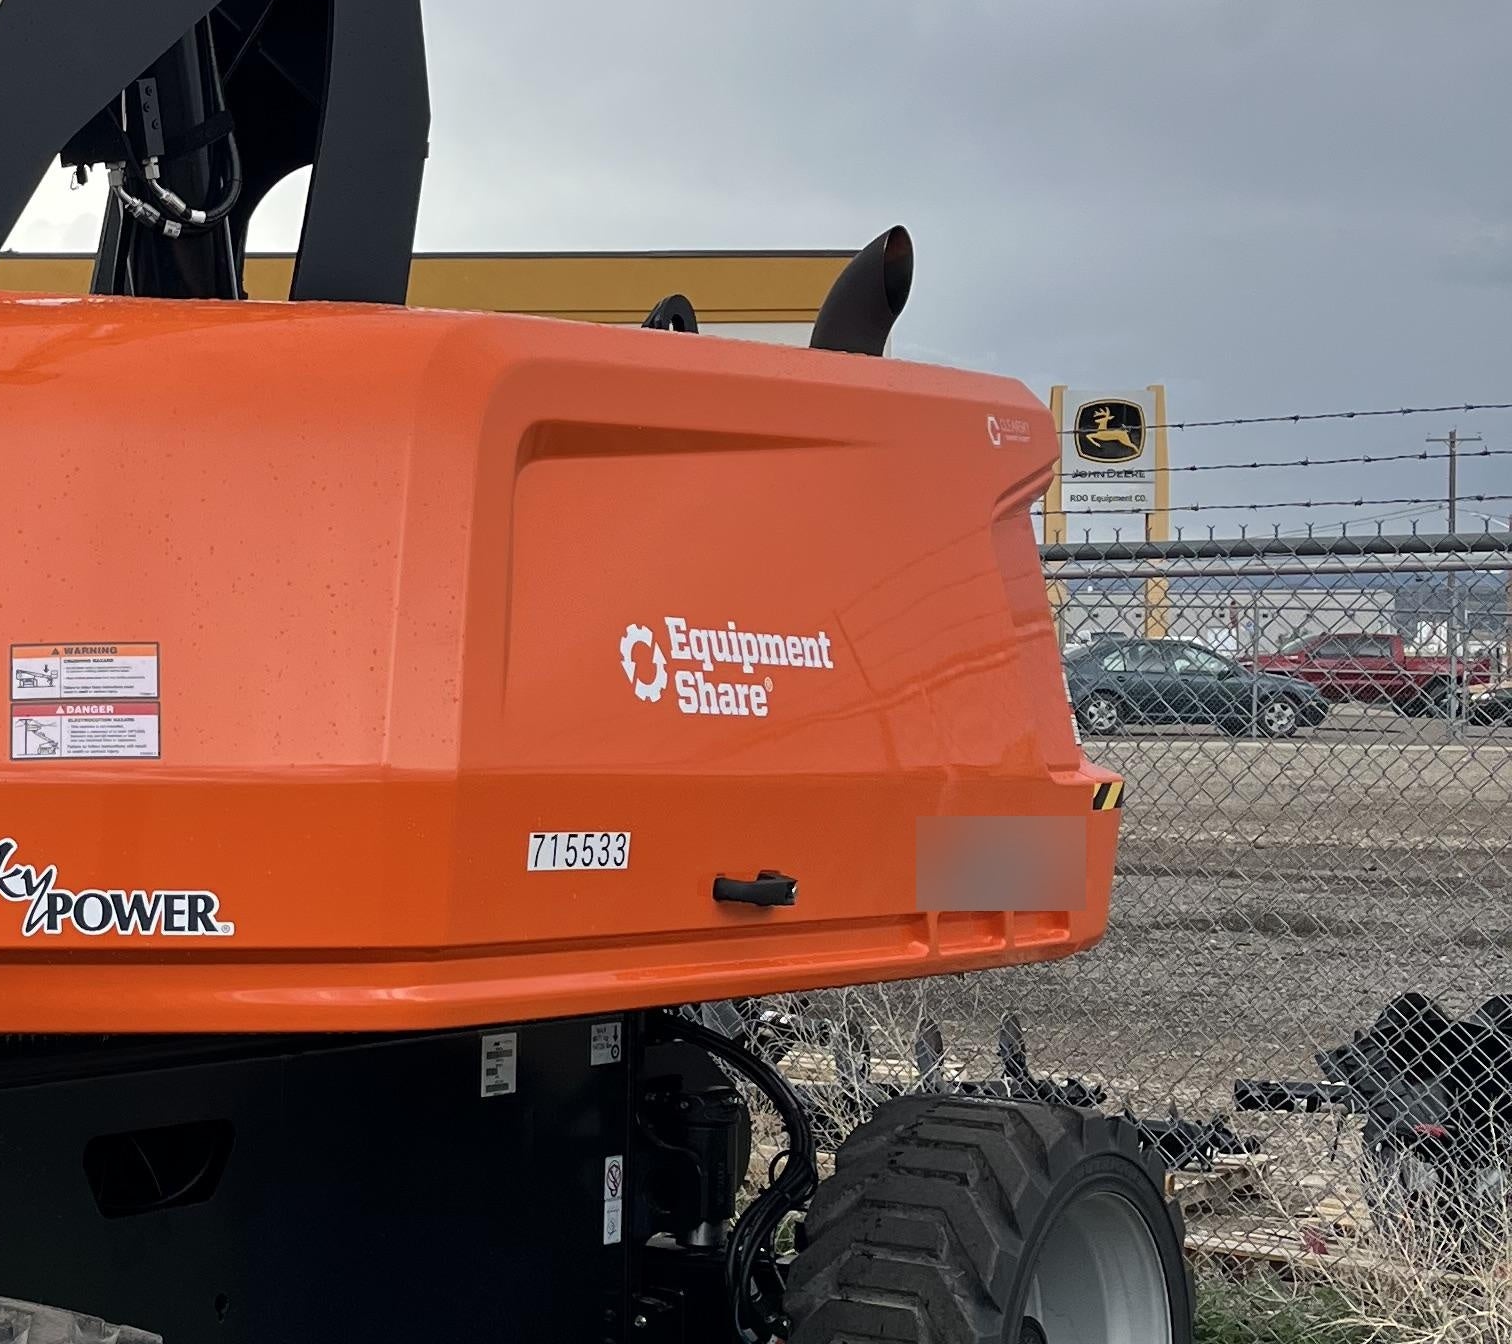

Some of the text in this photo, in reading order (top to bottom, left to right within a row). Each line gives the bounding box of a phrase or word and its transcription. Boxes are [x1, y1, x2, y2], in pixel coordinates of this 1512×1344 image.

[1091, 494, 1133, 504] Equipment
[64, 646, 118, 655] WARNING
[664, 617, 834, 674] Equipment
[66, 705, 114, 714] DANGER
[675, 671, 768, 717] Share
[533, 833, 627, 867] 715533
[45, 892, 220, 933] POWER
